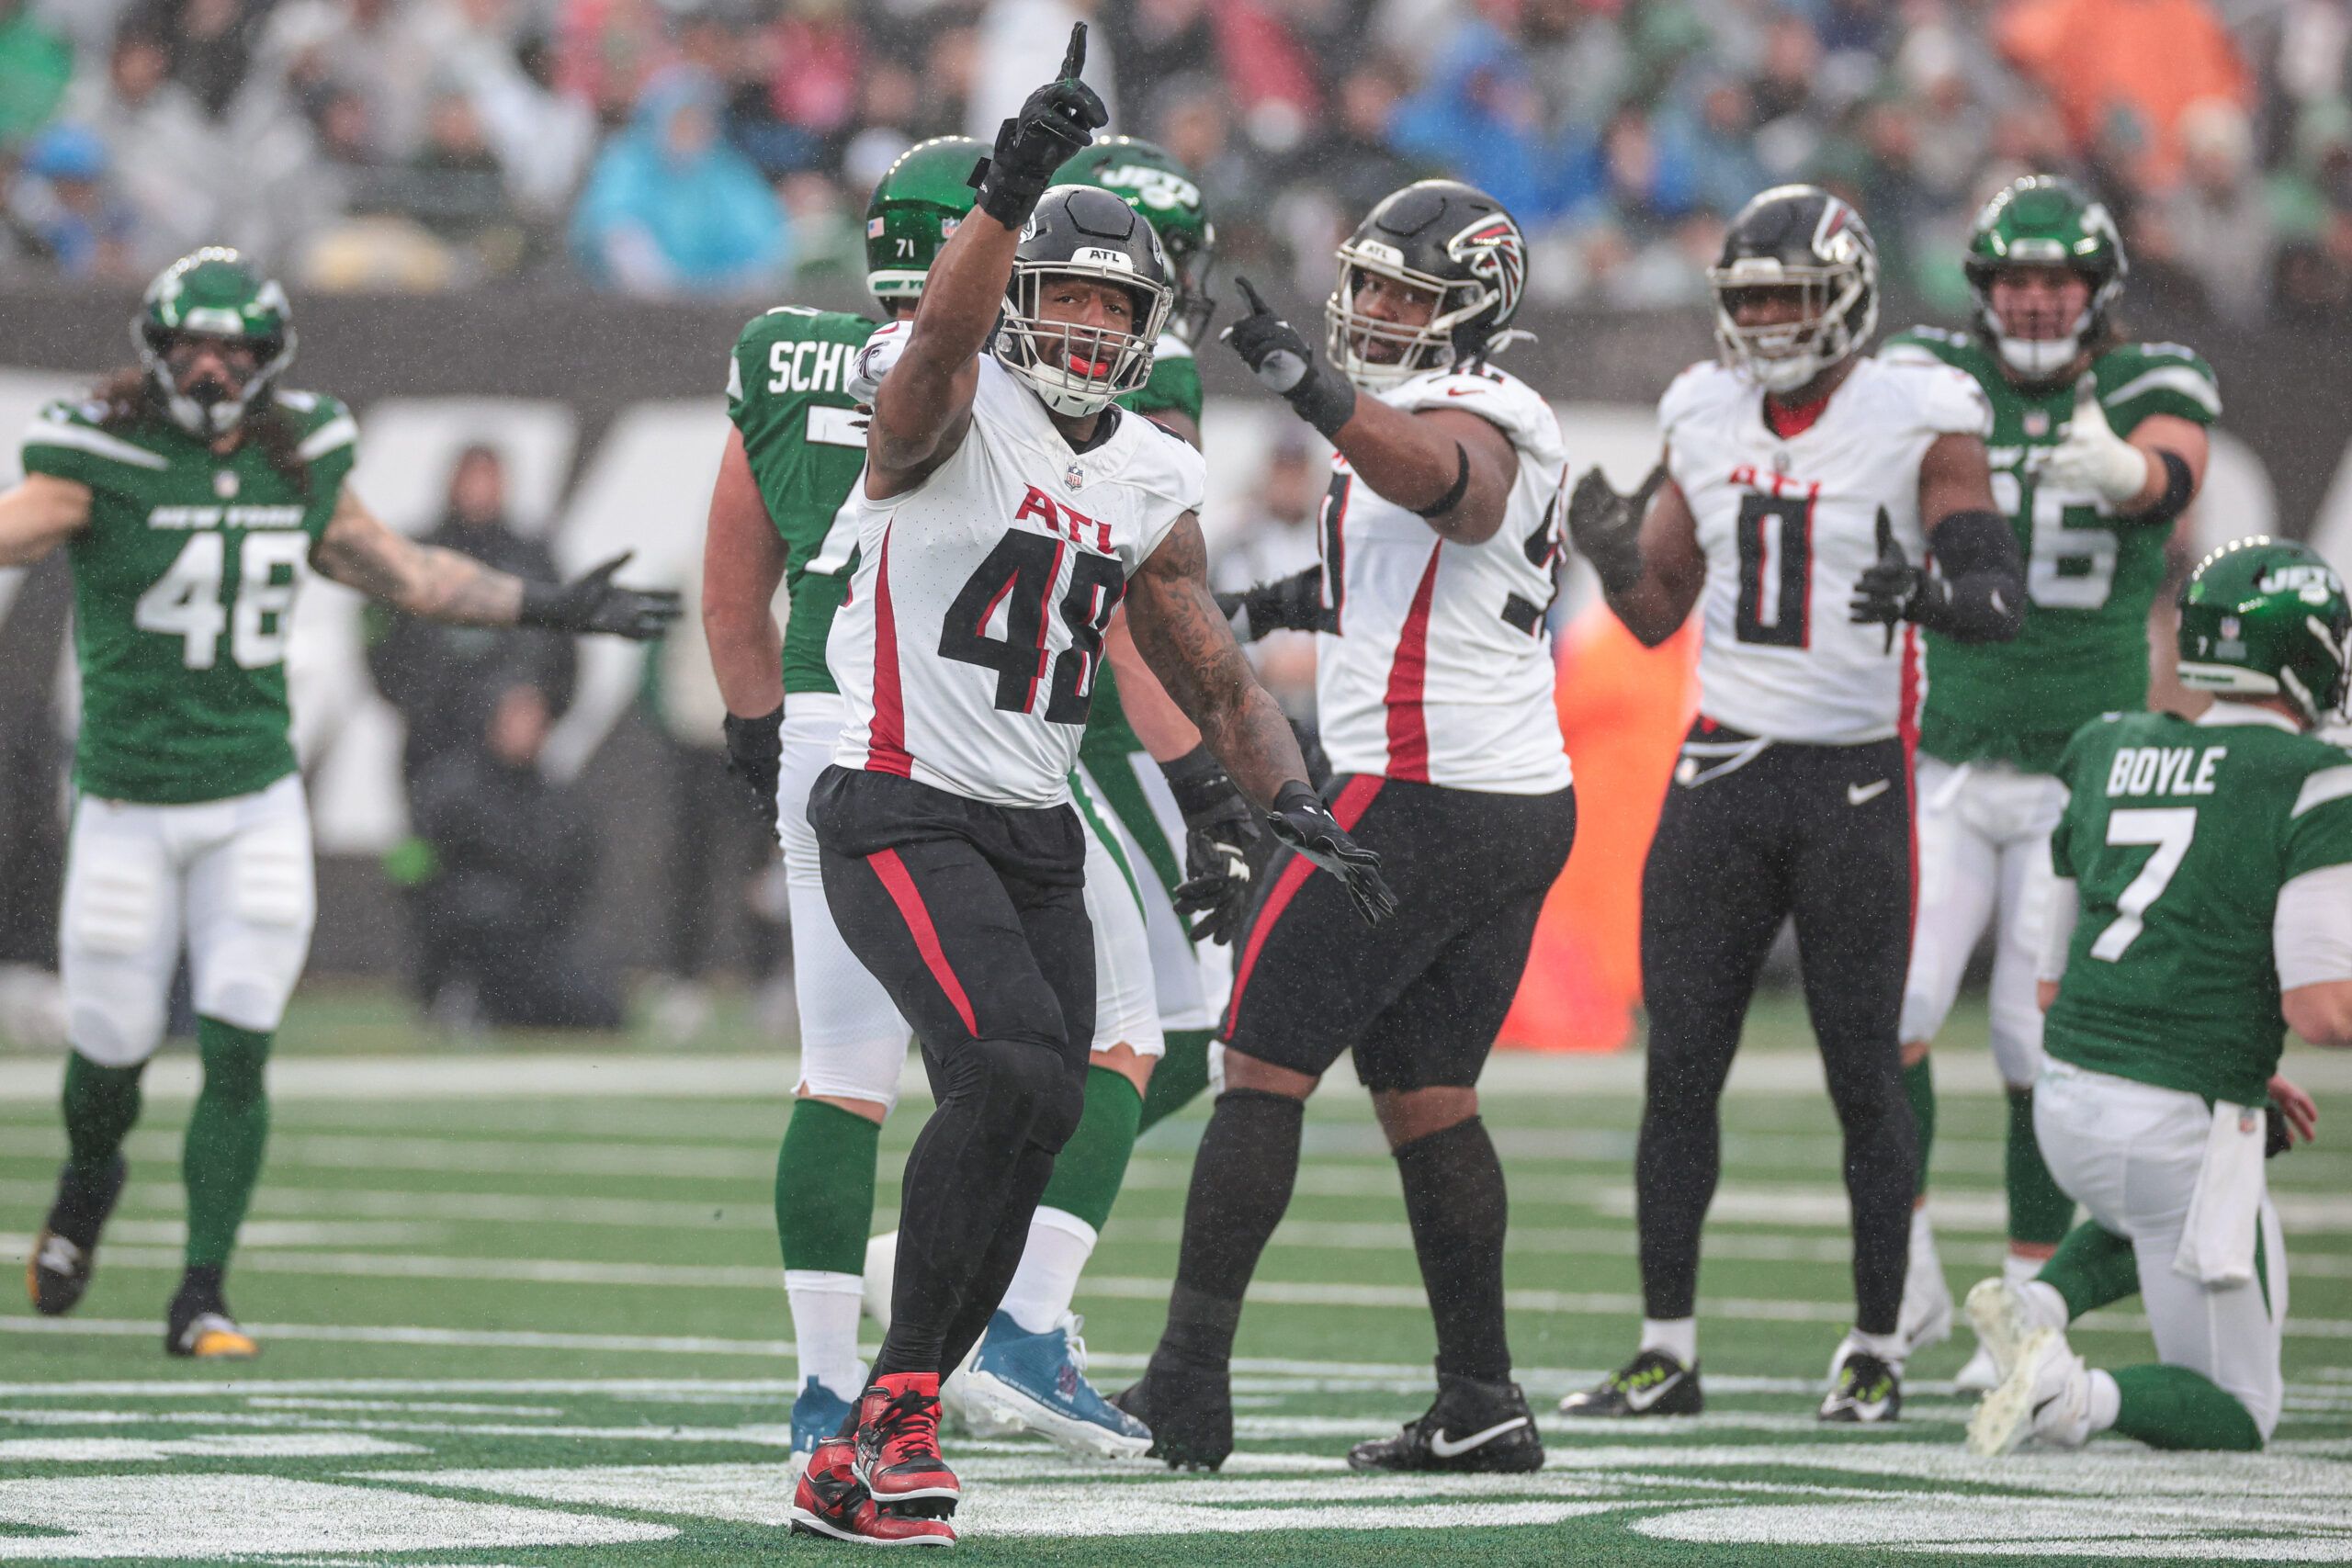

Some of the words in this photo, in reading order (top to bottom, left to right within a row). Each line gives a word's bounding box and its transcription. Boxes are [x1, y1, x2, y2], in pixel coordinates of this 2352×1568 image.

[896, 239, 914, 258] 71
[1090, 250, 1120, 263] ATL
[1014, 482, 1117, 555] ATL
[1736, 492, 1816, 651] 0
[938, 527, 1127, 726] 48
[2106, 746, 2228, 797] BOYLE
[2089, 807, 2198, 964] 7
